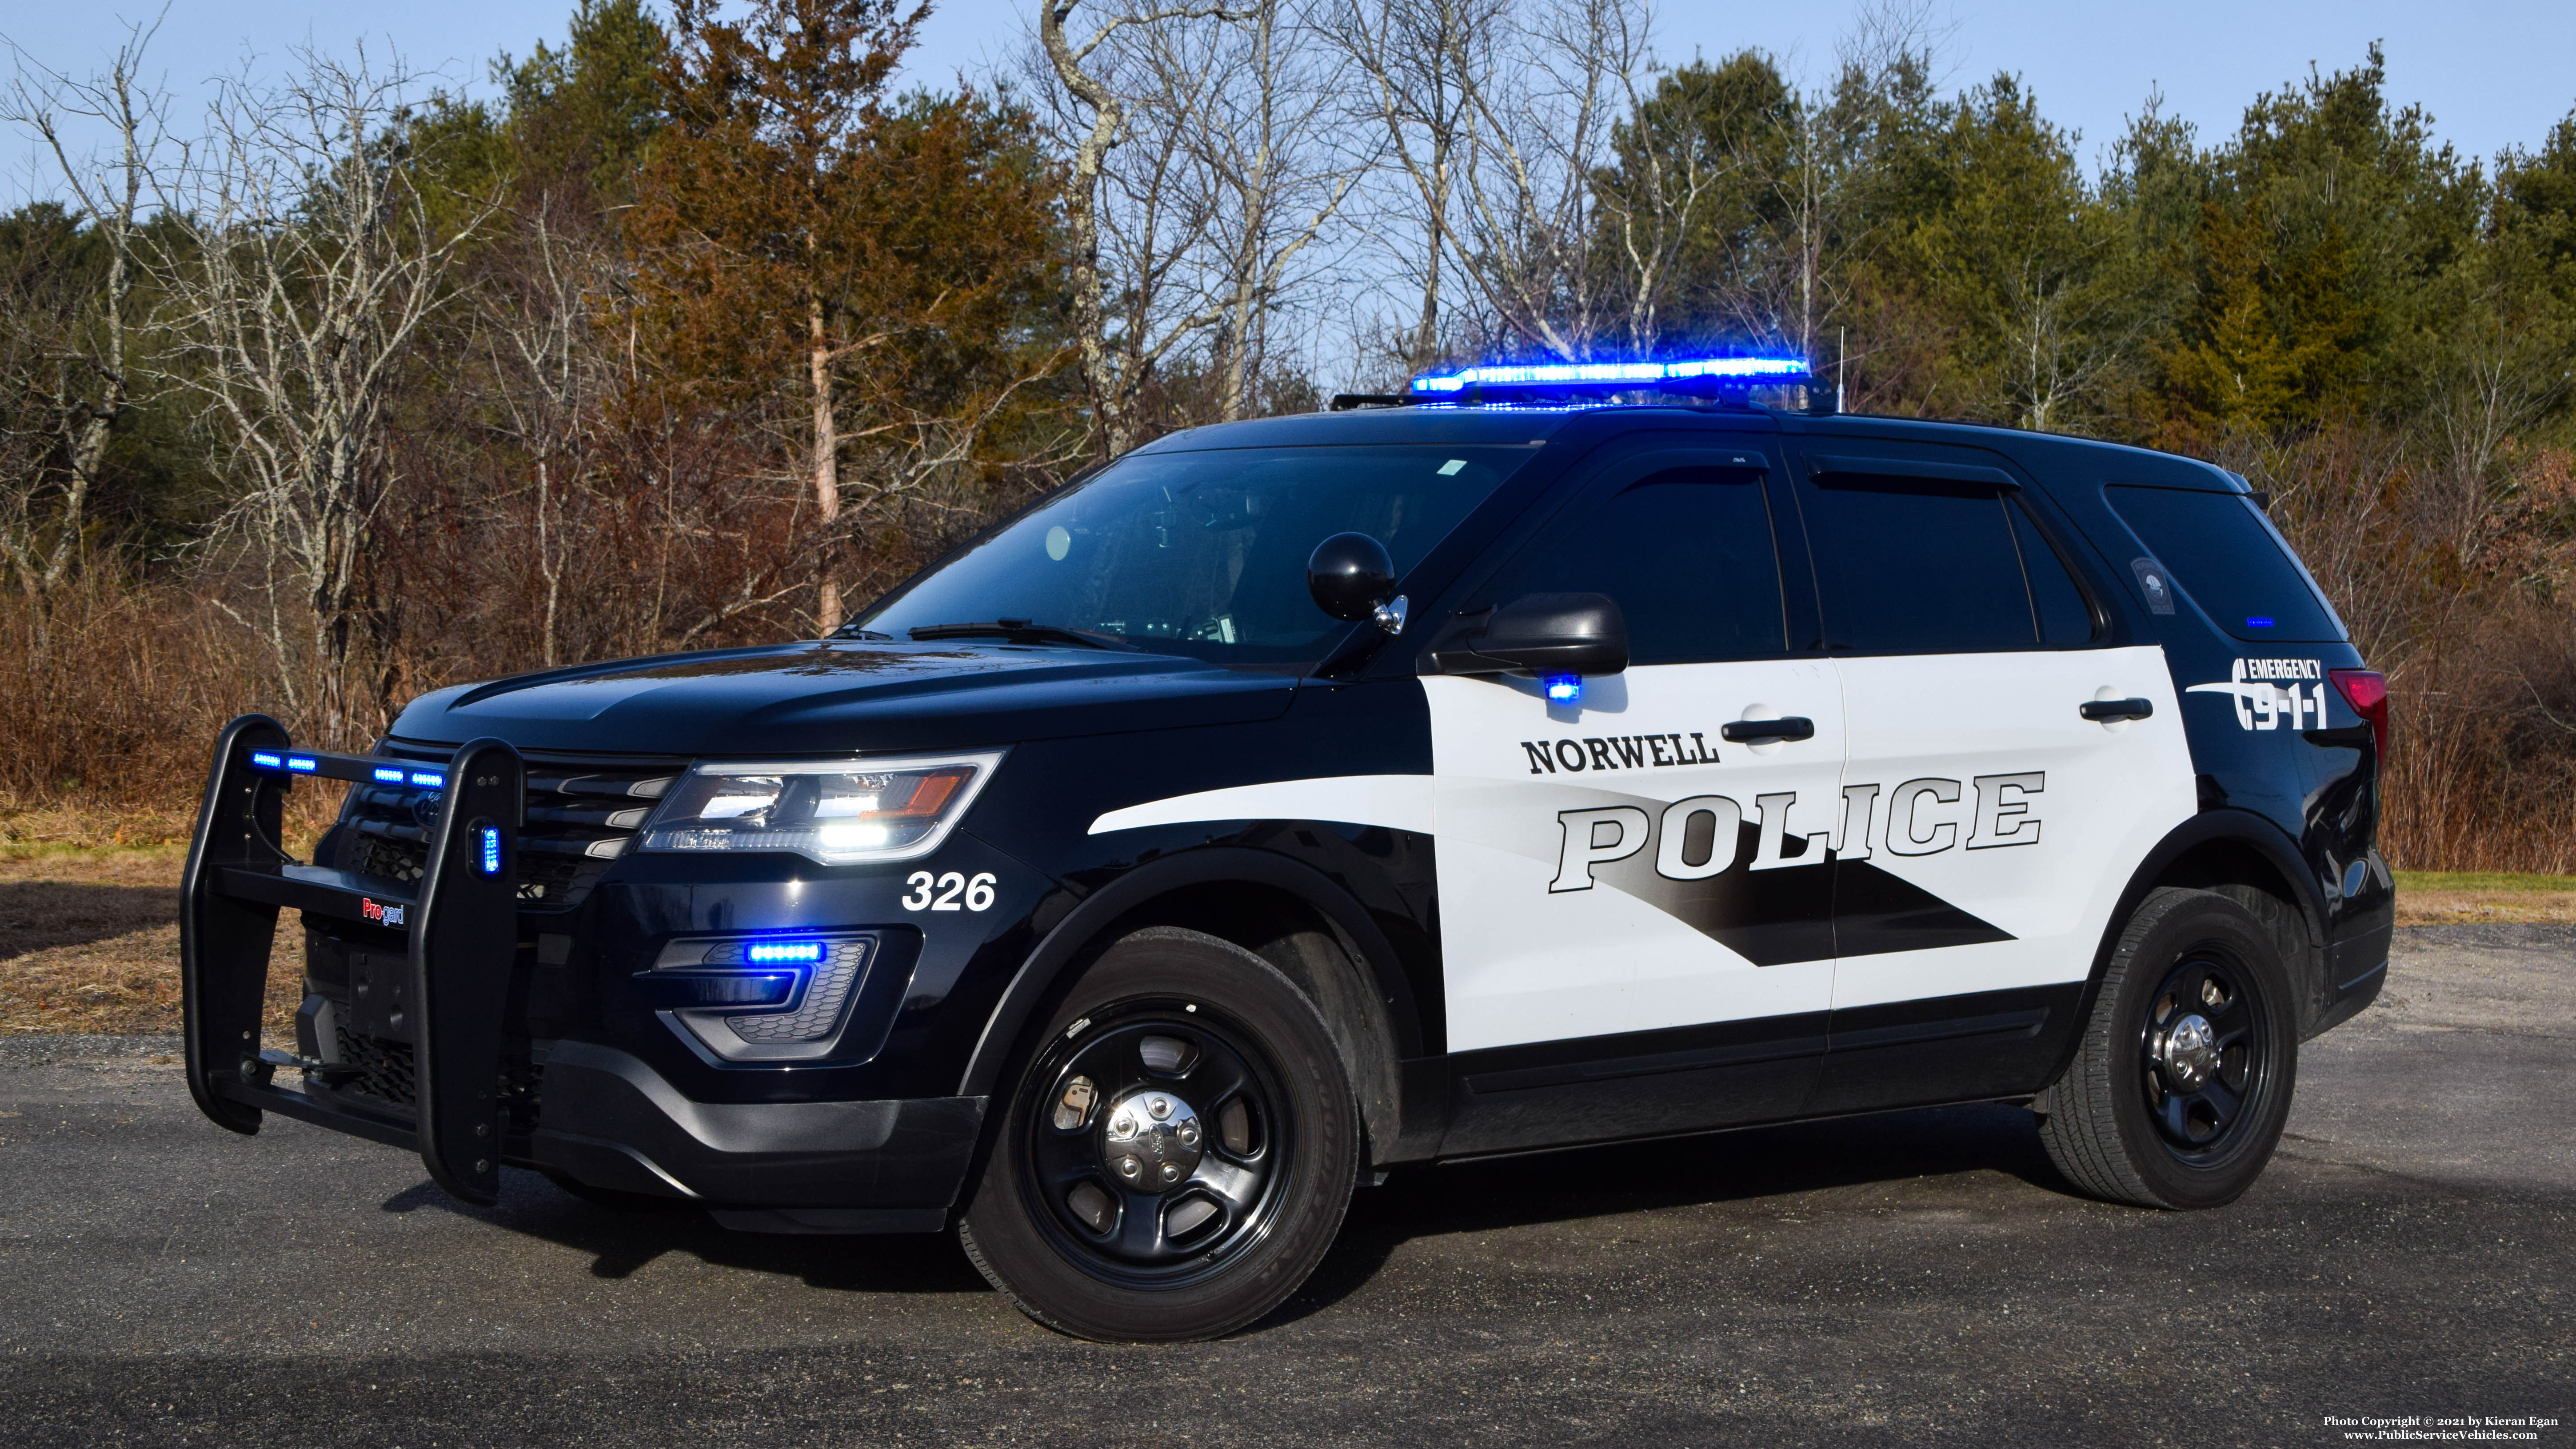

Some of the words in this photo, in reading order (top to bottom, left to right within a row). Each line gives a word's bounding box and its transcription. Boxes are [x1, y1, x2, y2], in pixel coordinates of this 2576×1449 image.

[2248, 659, 2321, 679] EMERGENCY
[2253, 683, 2327, 730] 9-1-1
[1521, 733, 1720, 774] NORWELL
[1548, 771, 2045, 894] POLICE
[902, 871, 996, 912] 326
